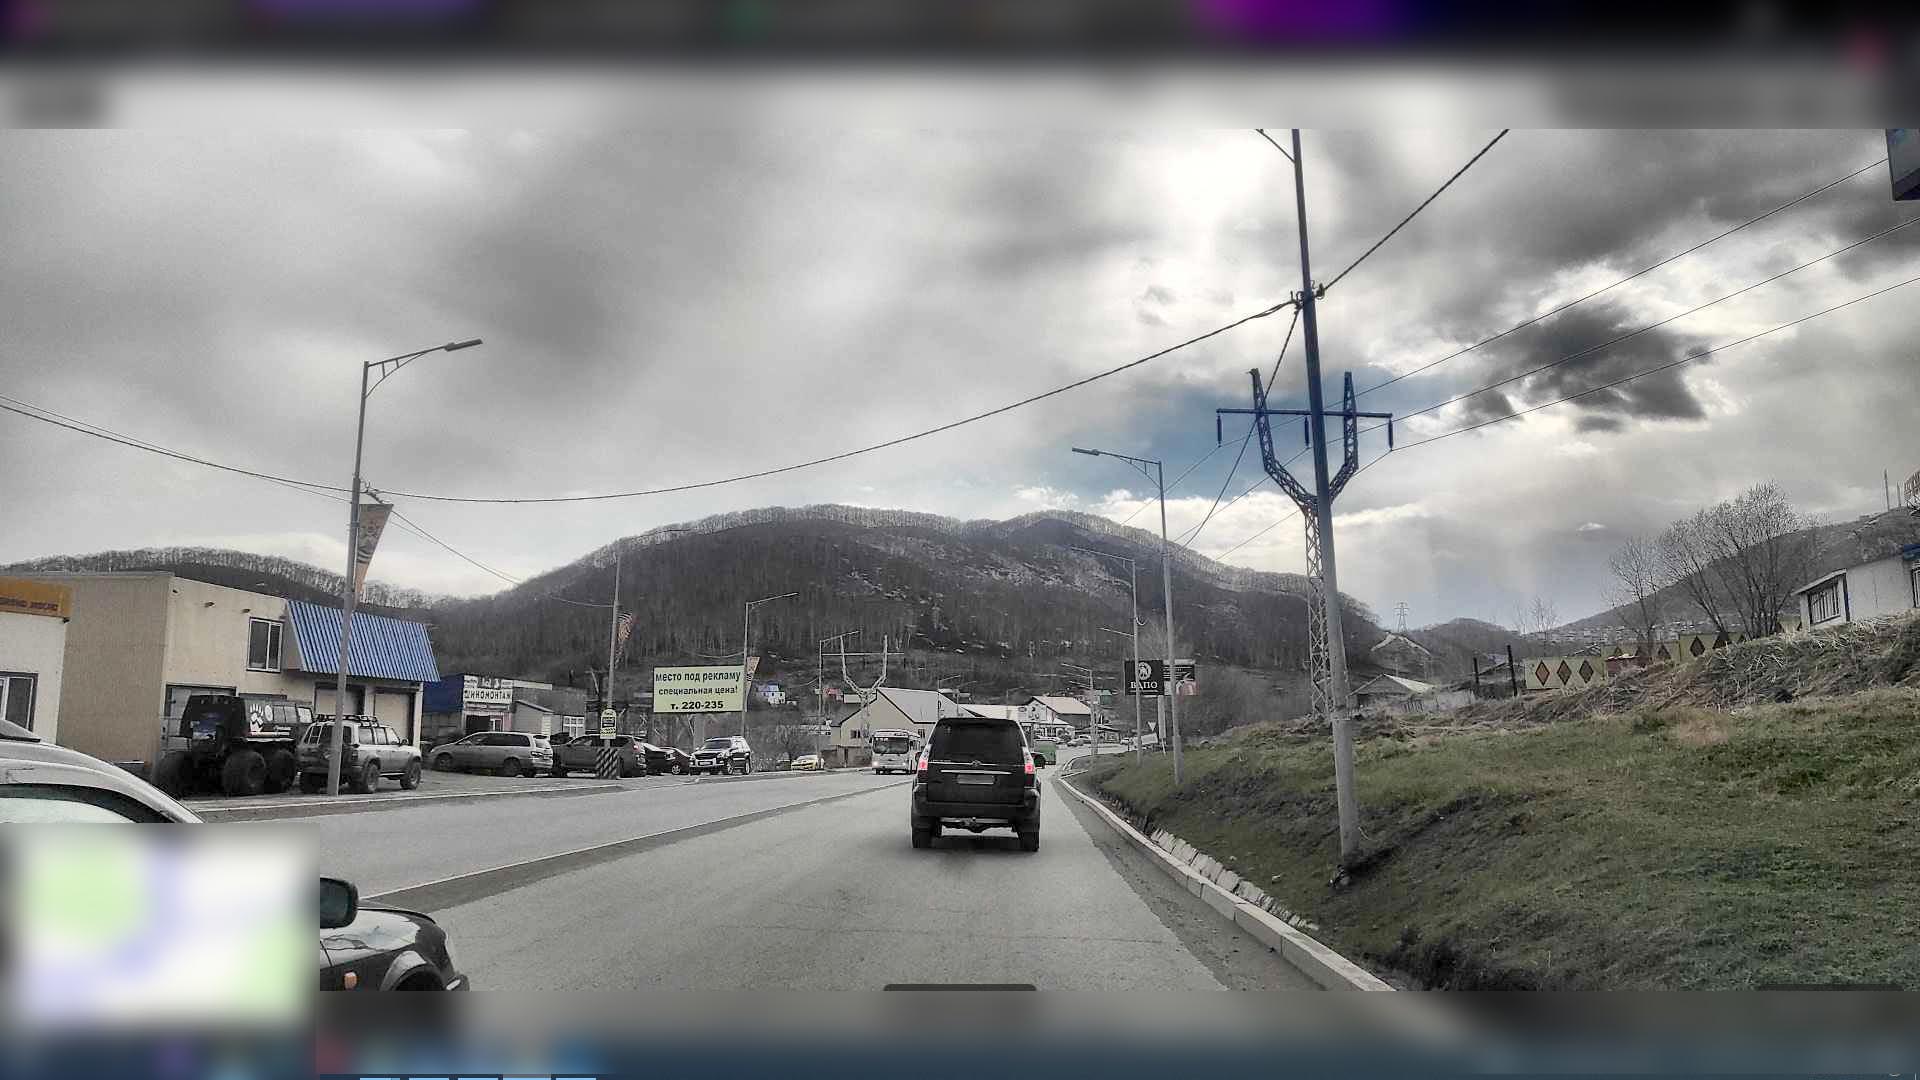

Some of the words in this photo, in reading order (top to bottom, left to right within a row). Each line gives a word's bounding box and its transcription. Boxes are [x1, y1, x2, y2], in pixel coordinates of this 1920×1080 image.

[684, 672, 701, 682] под
[702, 671, 741, 682] рекламу
[715, 685, 738, 695] цена!
[681, 700, 724, 710] 220-235
